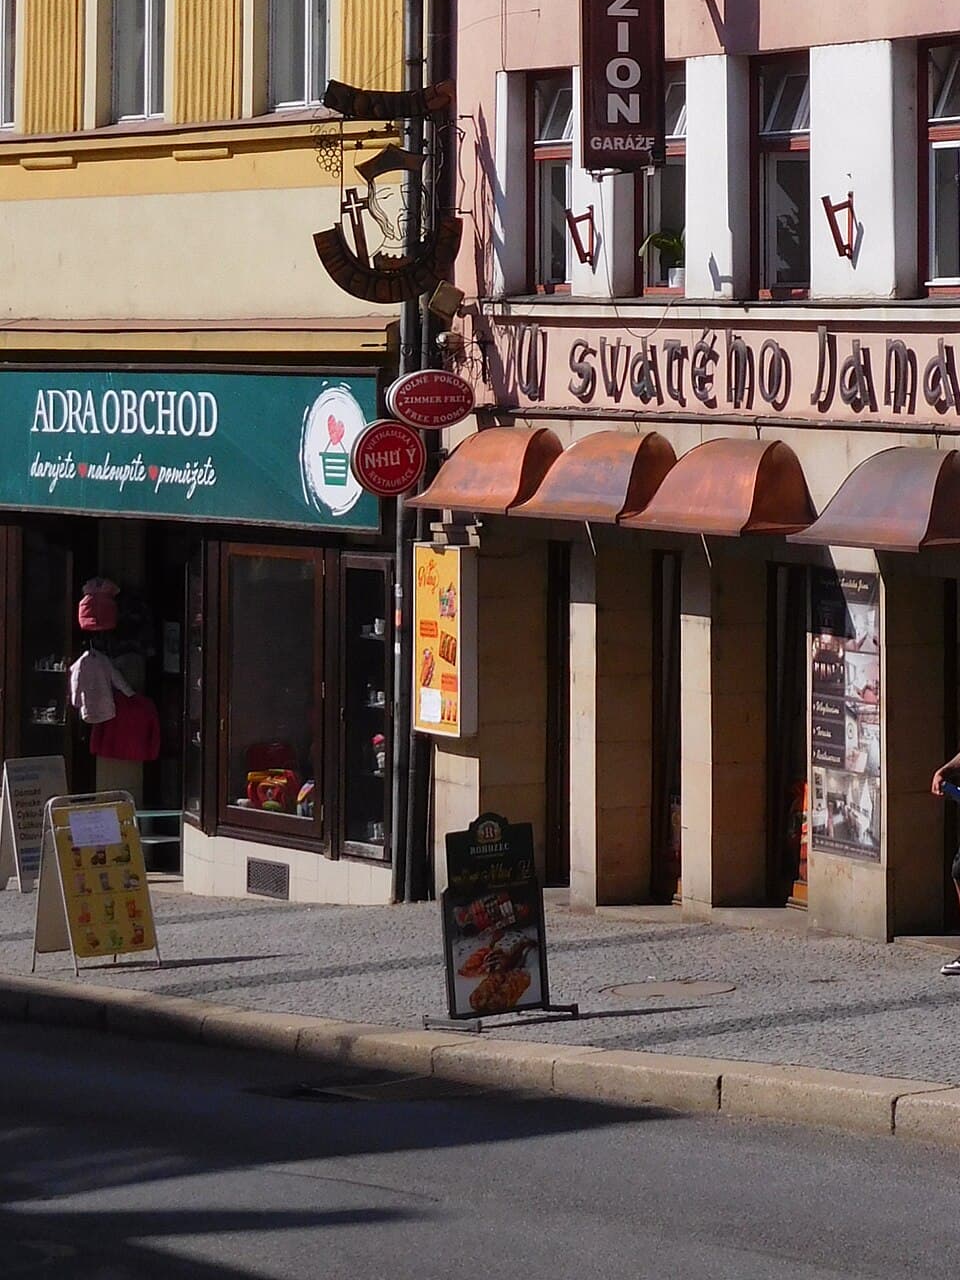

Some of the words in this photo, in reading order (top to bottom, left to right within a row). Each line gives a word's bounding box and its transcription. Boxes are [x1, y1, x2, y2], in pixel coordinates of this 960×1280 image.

[514, 323, 547, 401] U
[433, 375, 470, 395] POKOJE
[404, 396, 442, 404] ZIMMER
[444, 395, 465, 403] FREI
[31, 389, 100, 433] ADRA
[102, 389, 218, 437] OBCHOD
[405, 407, 430, 423] FREE
[433, 407, 466, 423] ROOMS
[30, 451, 77, 493] darujete
[87, 451, 147, 493] nakoupíte
[154, 456, 217, 500] pomůžete
[367, 467, 416, 489] RESTAURACE
